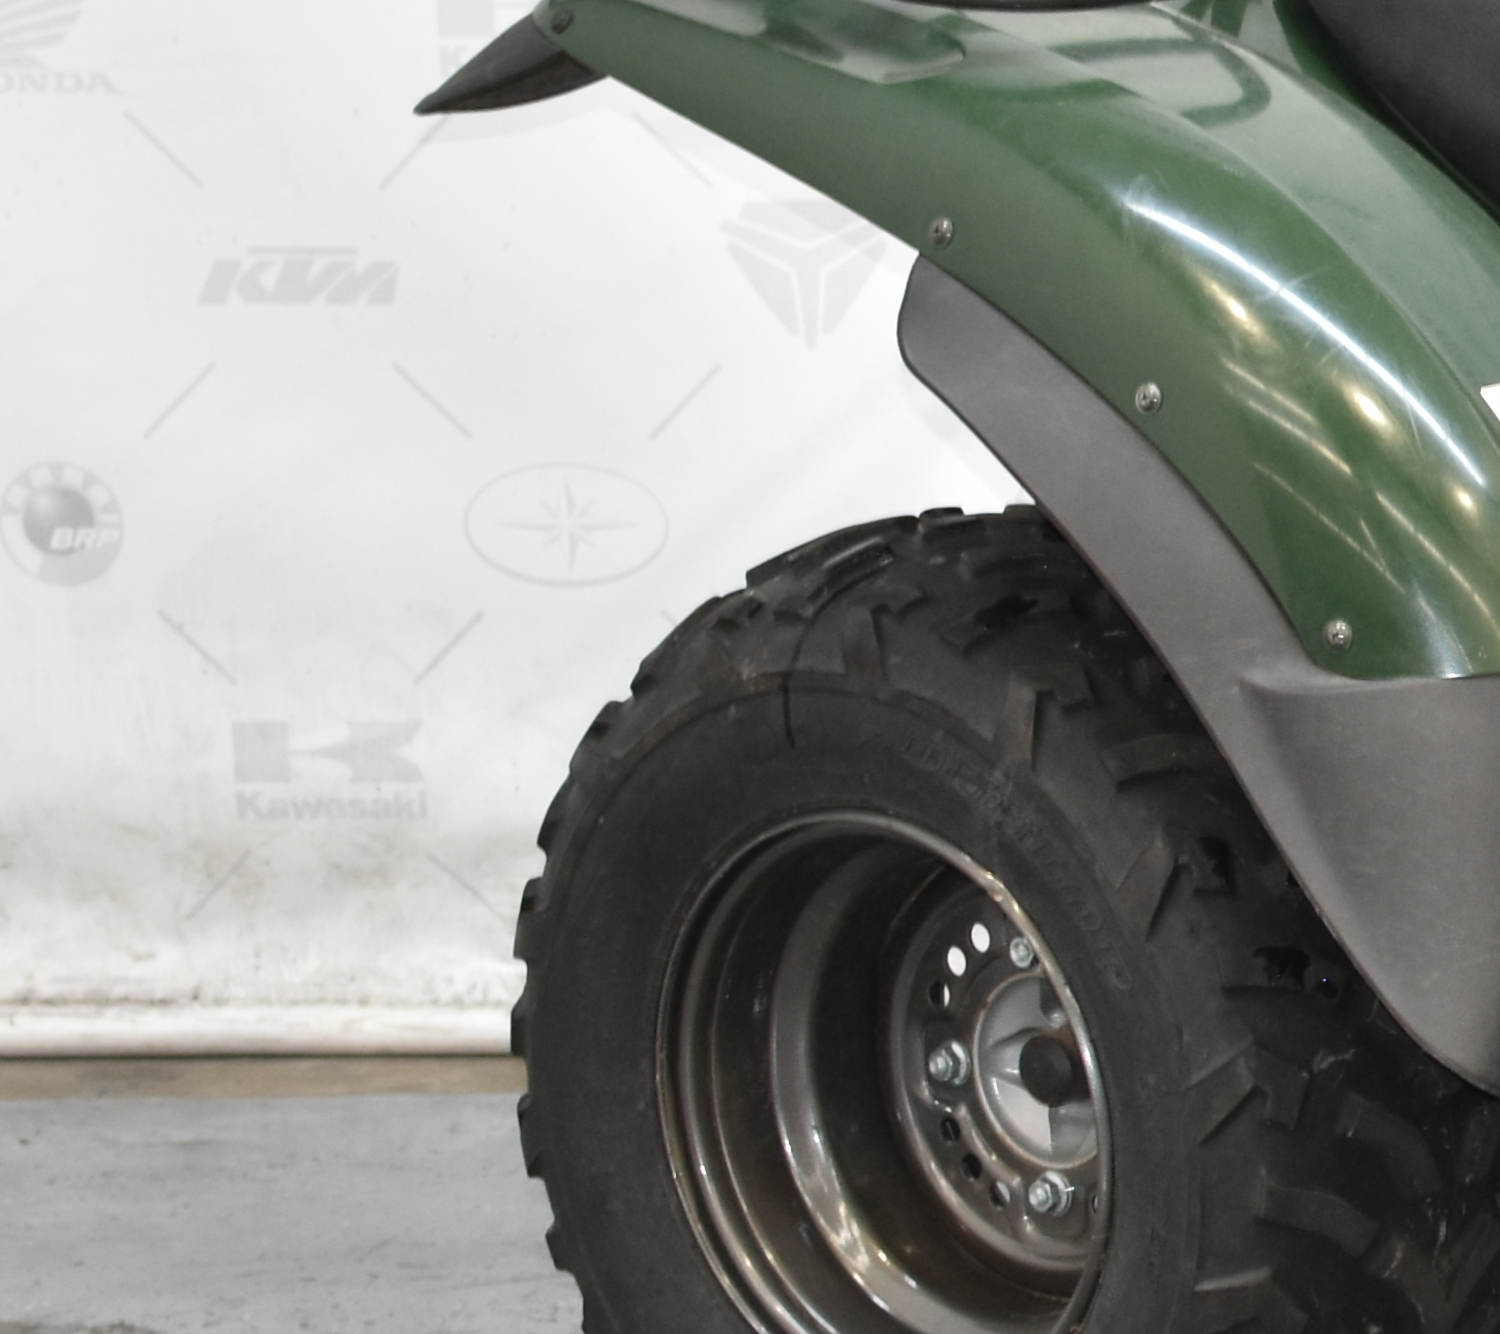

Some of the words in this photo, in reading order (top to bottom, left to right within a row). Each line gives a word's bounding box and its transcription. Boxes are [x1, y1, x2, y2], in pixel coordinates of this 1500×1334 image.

[198, 245, 401, 307] KTM
[50, 527, 122, 551] BRP
[235, 791, 430, 821] Kawasaki
